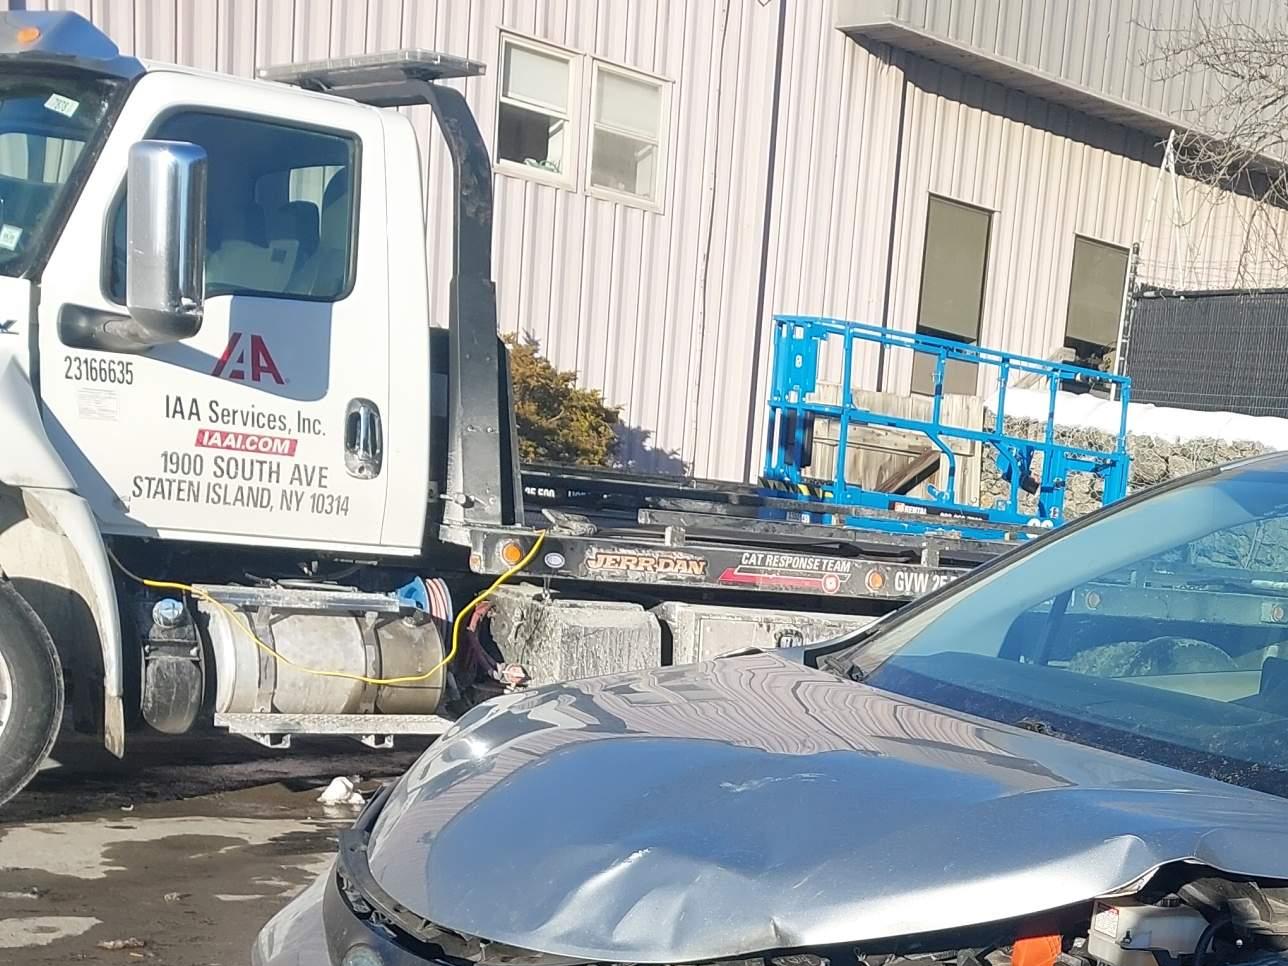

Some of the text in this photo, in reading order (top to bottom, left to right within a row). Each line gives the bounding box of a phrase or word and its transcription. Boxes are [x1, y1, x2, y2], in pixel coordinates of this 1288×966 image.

[64, 356, 134, 385] 23166635
[165, 394, 326, 437] IAA Services, Inc.
[201, 430, 291, 454] IAAI.COM
[161, 451, 329, 489] 1900 SOUTH AVE
[132, 475, 349, 517] STATEN ISLAND, NY 10314
[741, 552, 851, 573] CAT RESPONSE TEAM
[894, 571, 930, 593] GVW
